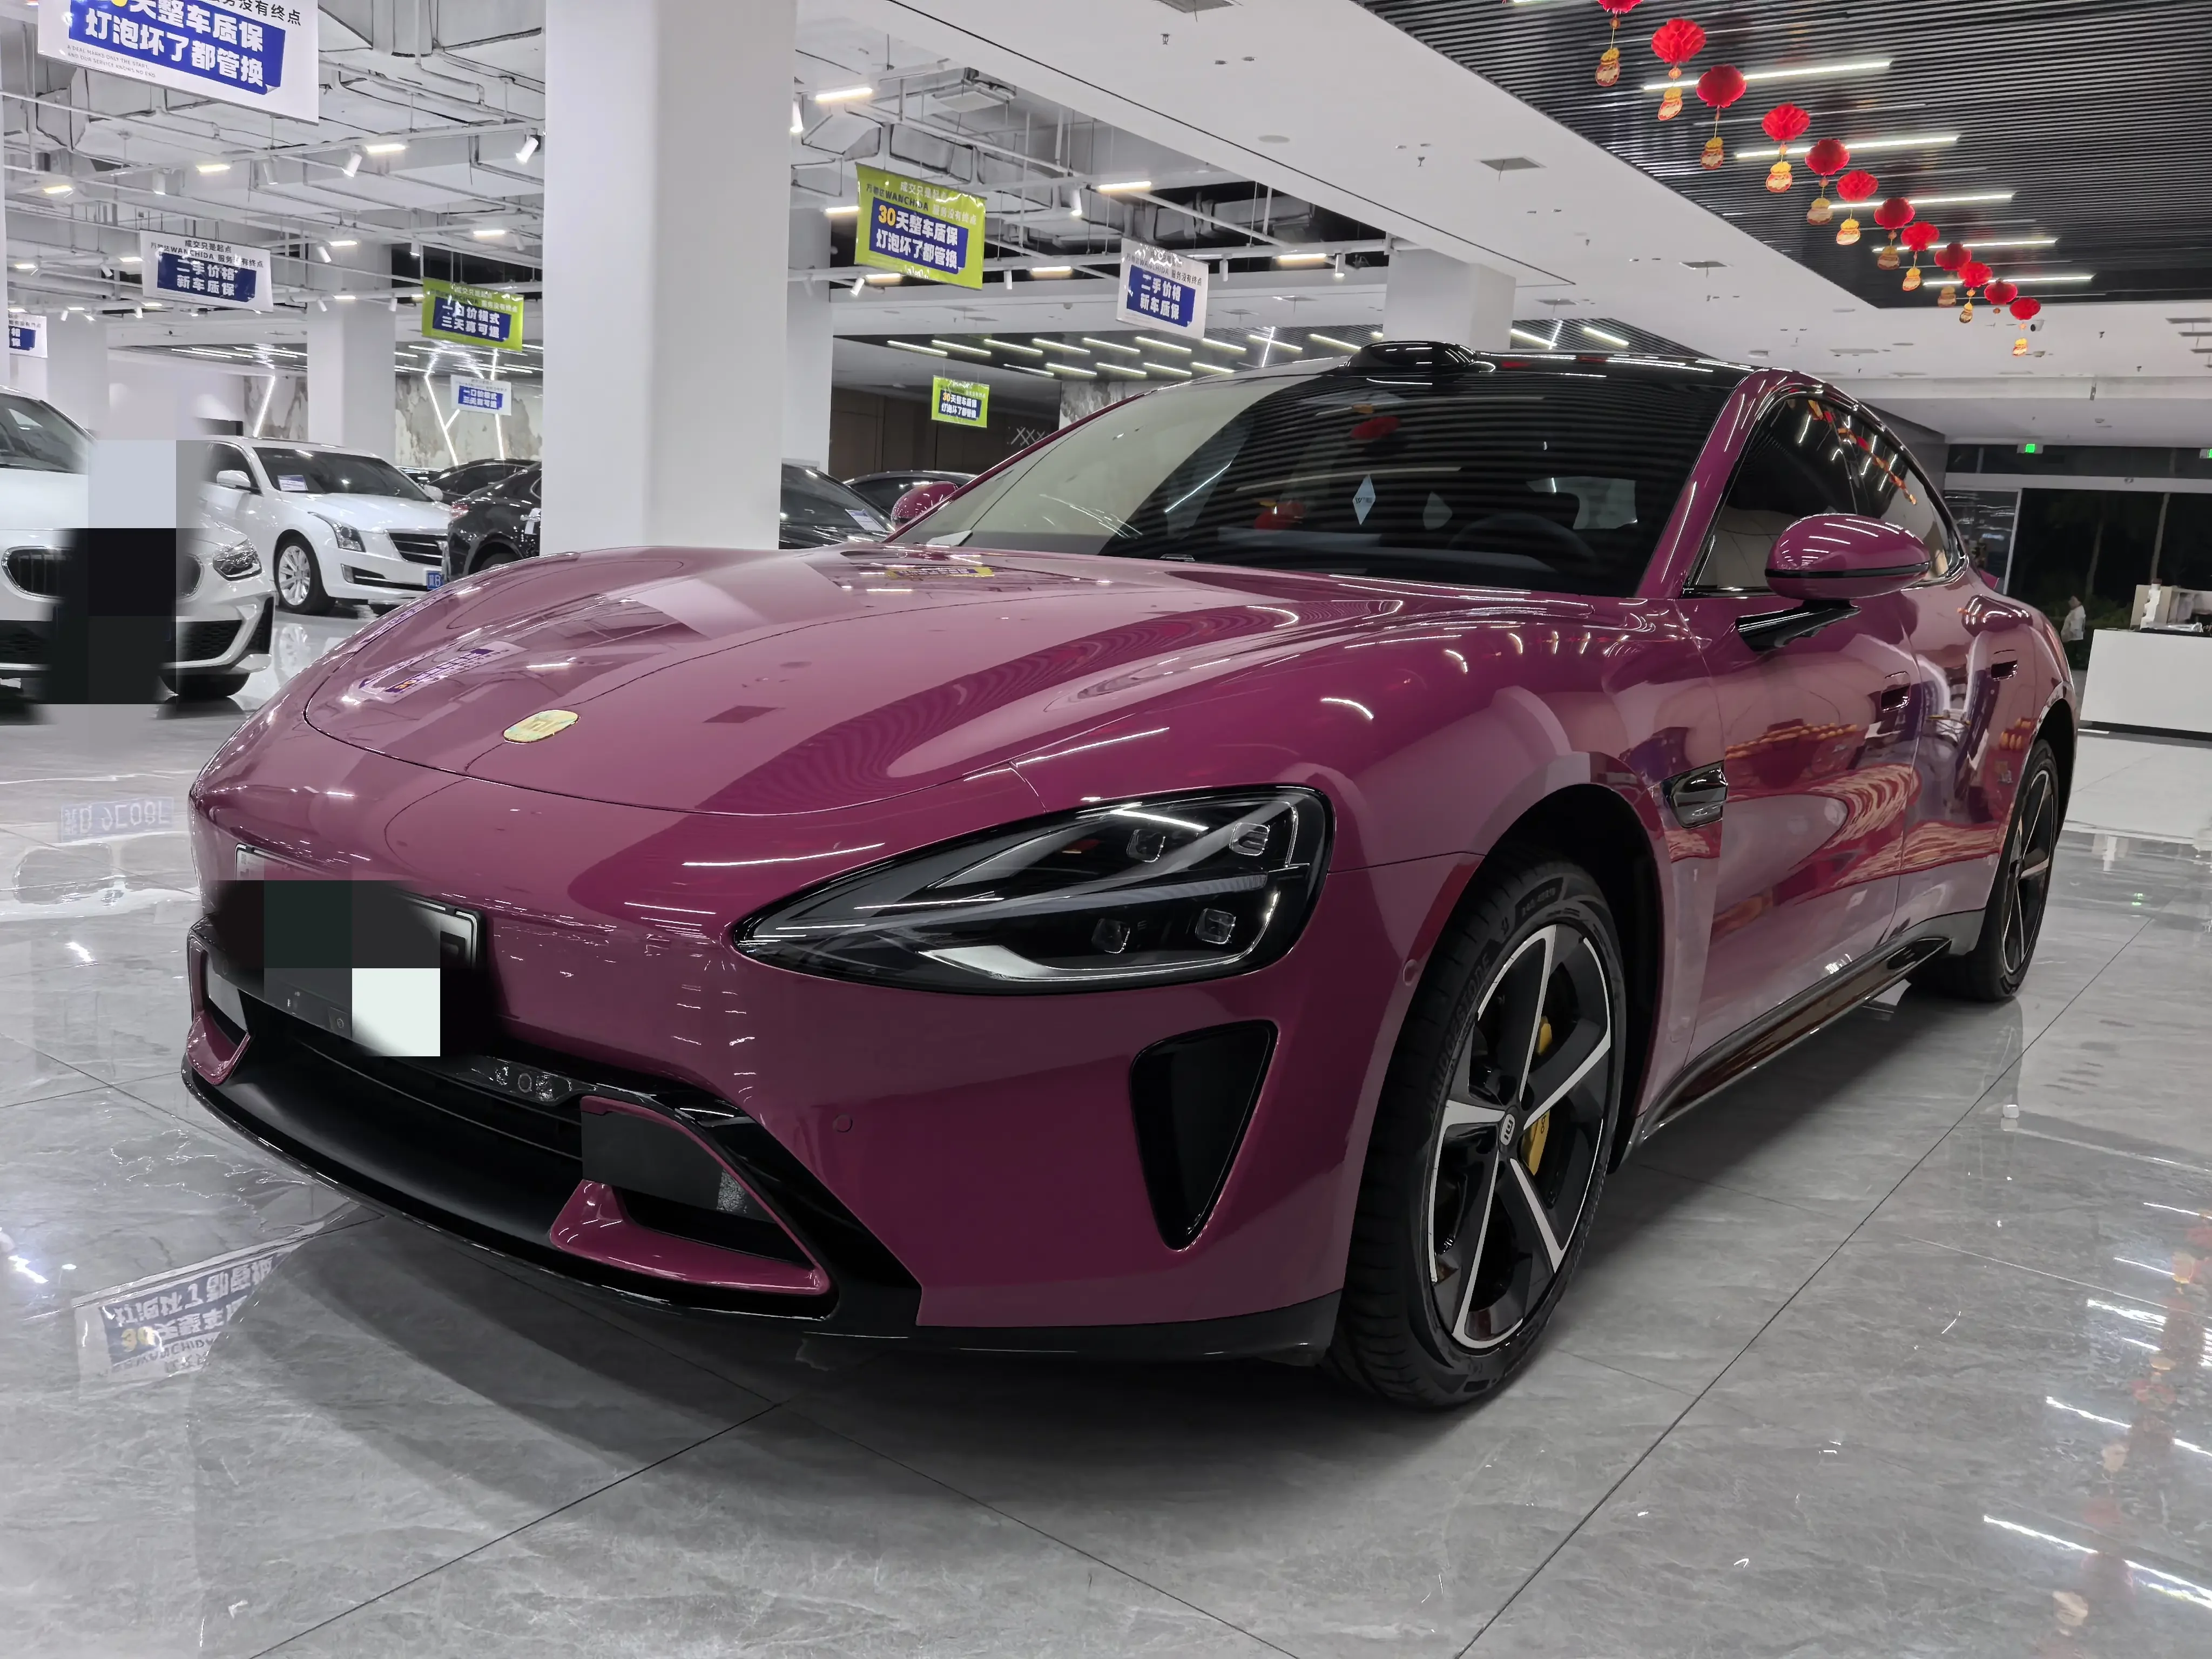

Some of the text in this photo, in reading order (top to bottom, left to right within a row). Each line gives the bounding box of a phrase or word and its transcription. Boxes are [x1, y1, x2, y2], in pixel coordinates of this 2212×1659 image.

[85, 8, 263, 87] 灯泡坏了都管换
[878, 204, 958, 246] 30天整车质保
[876, 228, 957, 269] 灯泡坏了都管换
[177, 259, 235, 282] 二手价格
[177, 274, 235, 296] 新车质保
[1141, 273, 1182, 302] 二手价格
[1139, 292, 1180, 320] 新车质保
